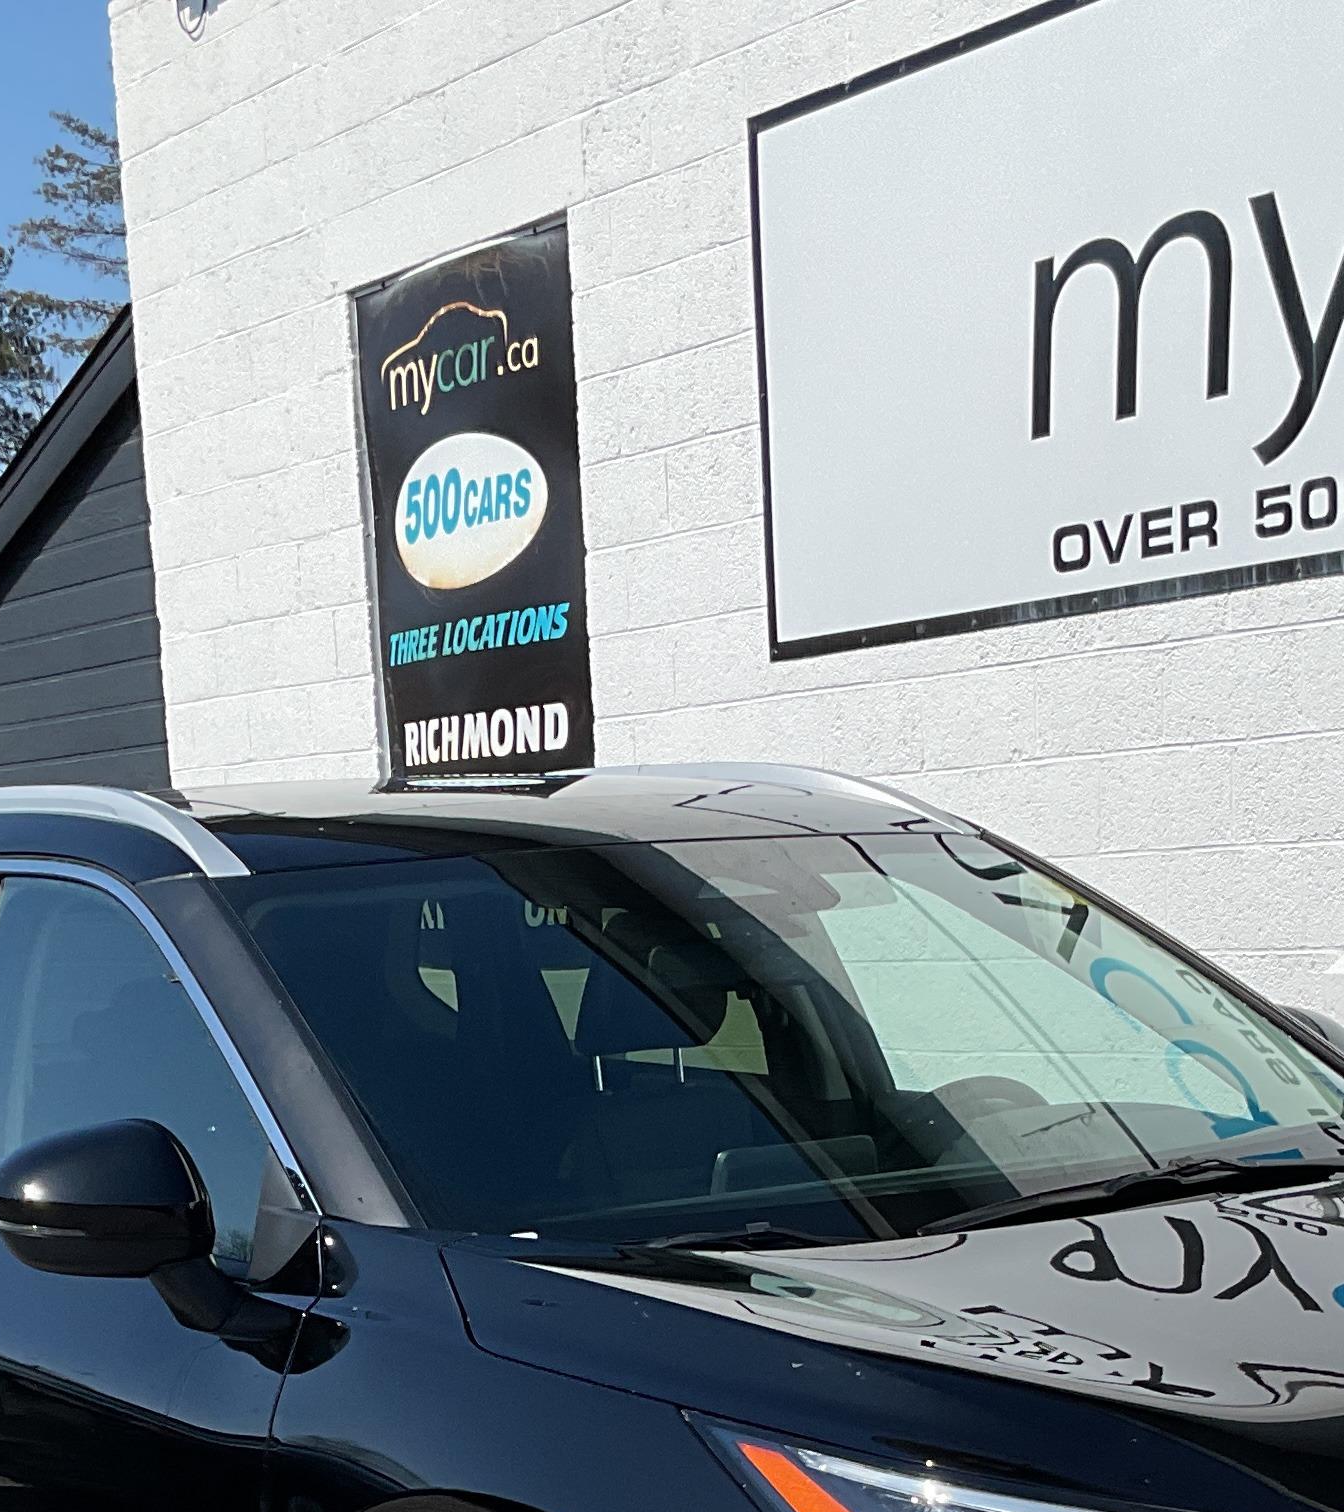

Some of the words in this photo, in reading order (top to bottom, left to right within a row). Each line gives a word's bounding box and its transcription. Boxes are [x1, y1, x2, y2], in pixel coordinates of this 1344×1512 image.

[388, 335, 539, 415] mycar.ca
[1052, 499, 1220, 574] OVER
[388, 623, 440, 667] THREE
[441, 602, 570, 656] LOCATIONS
[403, 702, 568, 767] RICHMOND
